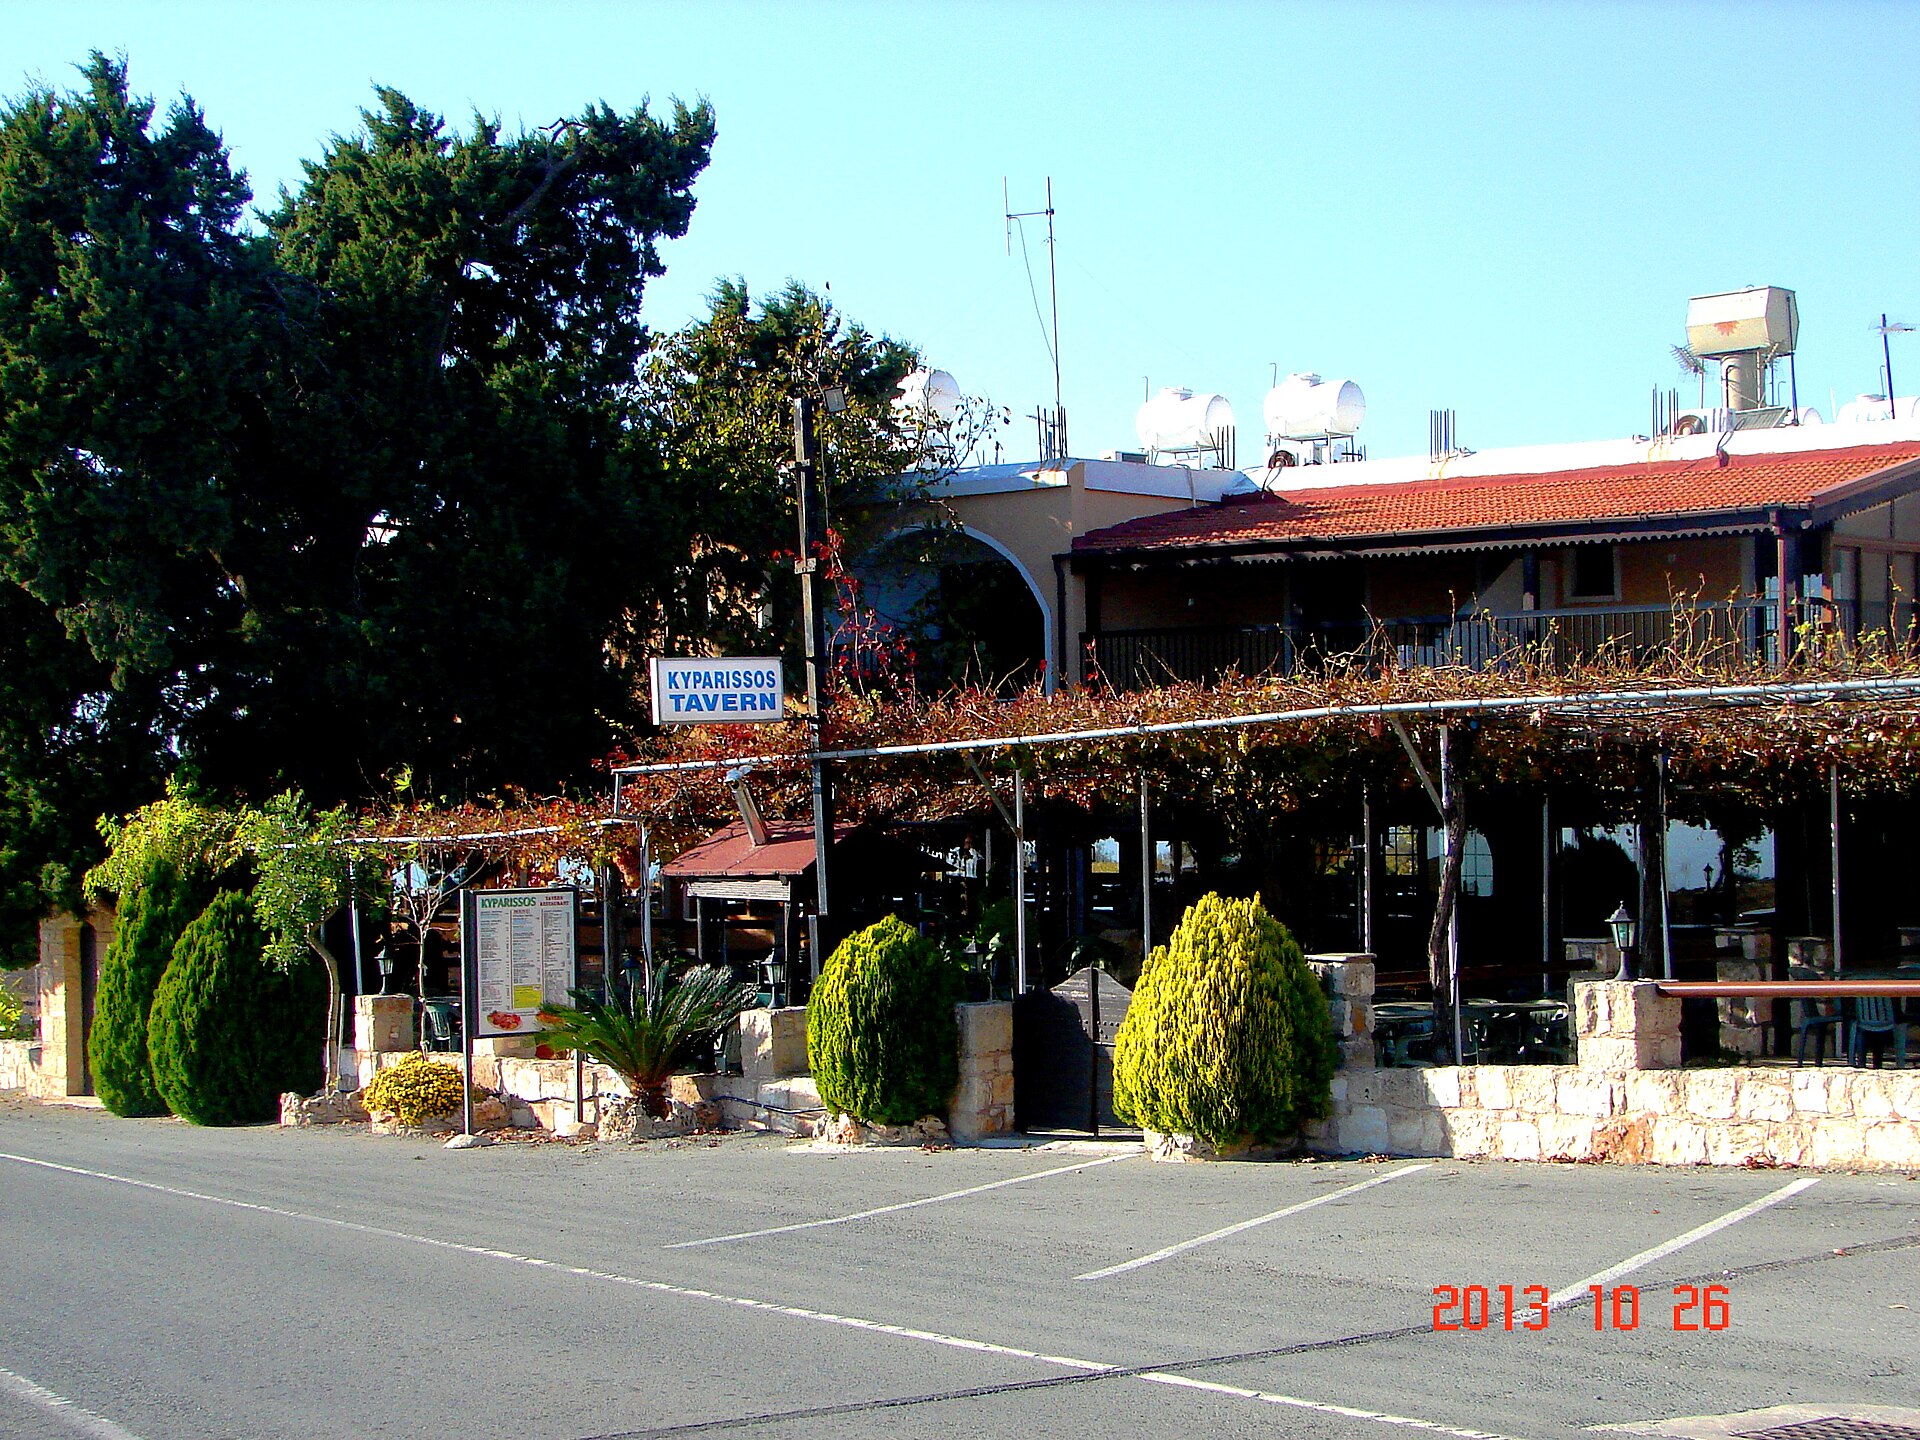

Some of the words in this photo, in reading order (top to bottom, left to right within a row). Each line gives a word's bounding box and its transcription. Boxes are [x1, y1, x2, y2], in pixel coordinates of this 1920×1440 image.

[668, 670, 776, 689] KYPARISSOS
[669, 693, 776, 712] TAVERN
[481, 897, 537, 908] KYPARISSOS
